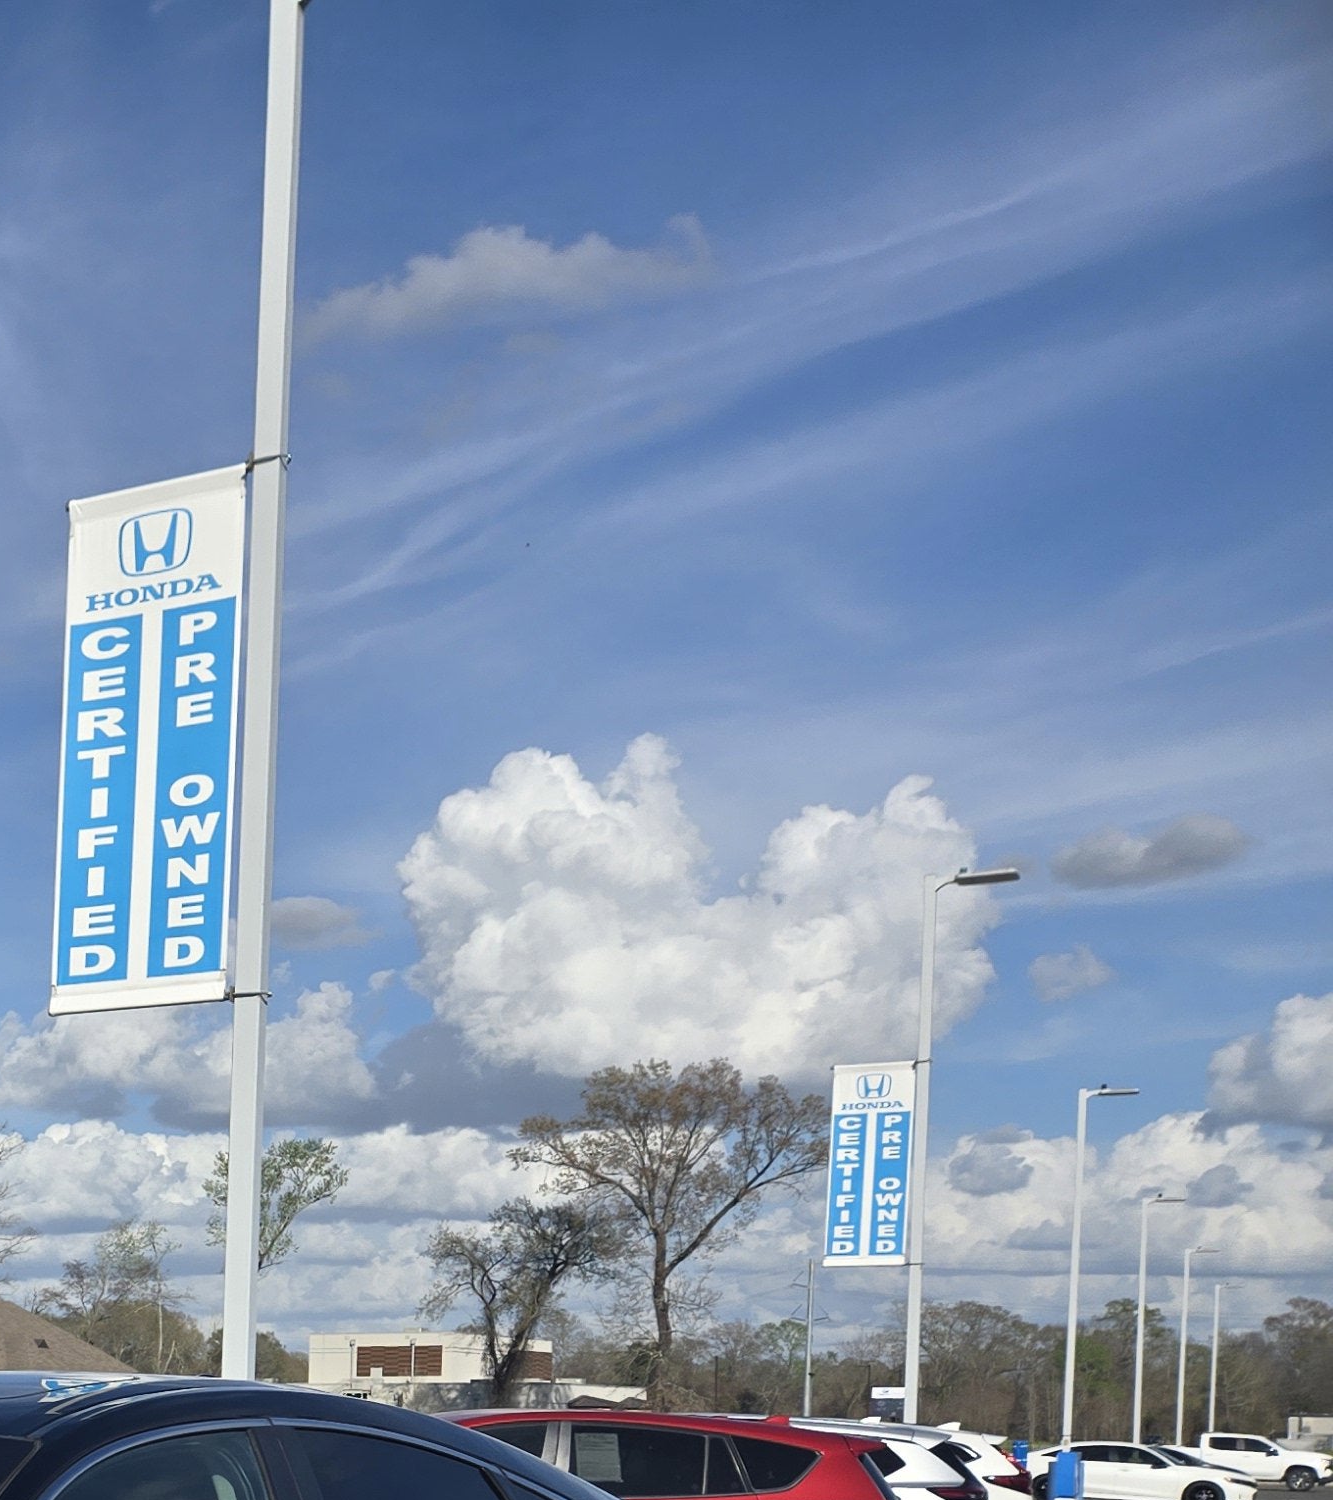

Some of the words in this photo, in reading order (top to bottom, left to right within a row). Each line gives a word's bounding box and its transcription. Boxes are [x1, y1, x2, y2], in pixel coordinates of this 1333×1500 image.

[85, 573, 222, 613] HONDA
[175, 611, 218, 728] PRE
[68, 627, 131, 977] CERTIFIED
[160, 773, 221, 969] OWNED
[840, 1100, 905, 1111] HONDA
[882, 1114, 902, 1160] PRE
[832, 1116, 862, 1255] CERTIFIED
[875, 1177, 904, 1254] OWNED
